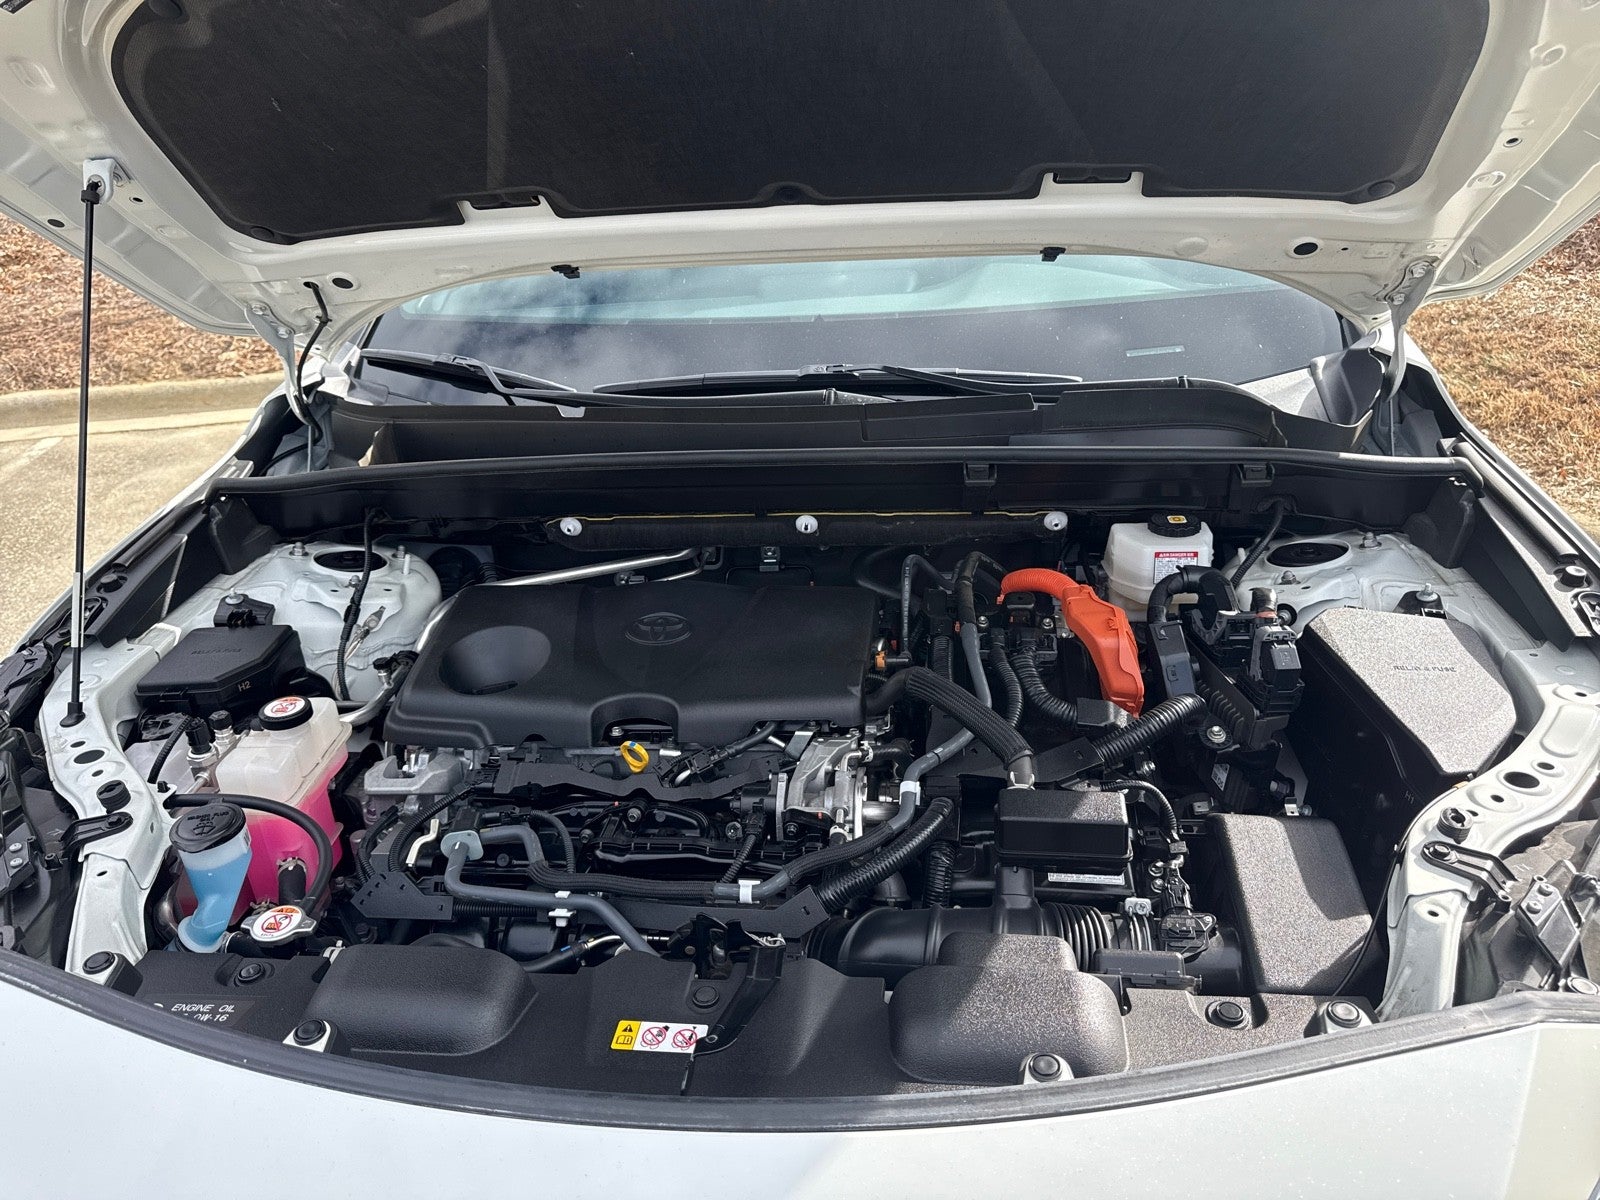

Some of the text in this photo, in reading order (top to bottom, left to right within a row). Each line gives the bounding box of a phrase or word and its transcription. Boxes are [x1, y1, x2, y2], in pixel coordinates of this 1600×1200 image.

[237, 680, 251, 692] H2
[171, 1003, 235, 1013] ENGINE OIL
